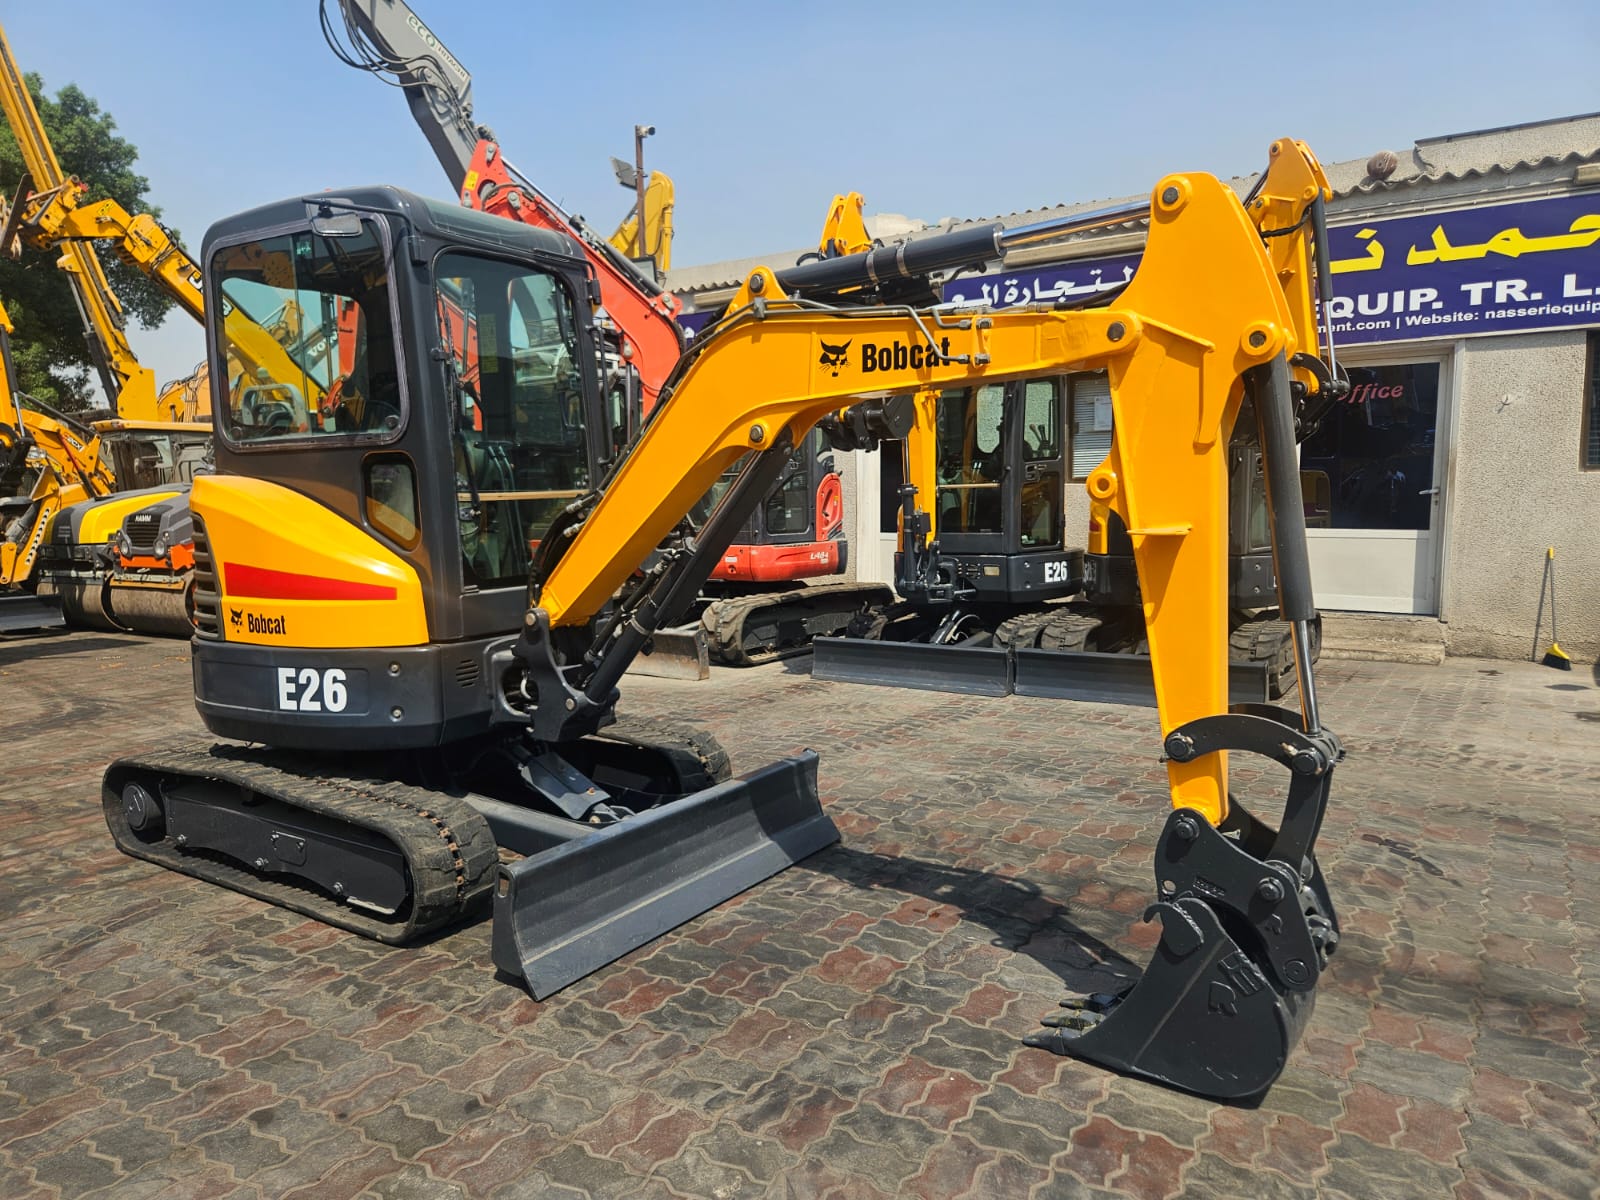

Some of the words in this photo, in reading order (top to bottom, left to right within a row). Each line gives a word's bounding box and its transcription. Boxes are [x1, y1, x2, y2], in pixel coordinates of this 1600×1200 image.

[1315, 288, 1443, 319] QUIP.
[1461, 279, 1543, 306] TR.
[1405, 311, 1479, 326] Website:
[862, 337, 950, 373] Bobcat
[1044, 560, 1068, 583] E26
[247, 612, 287, 635] Bobcat
[277, 667, 348, 713] E26
